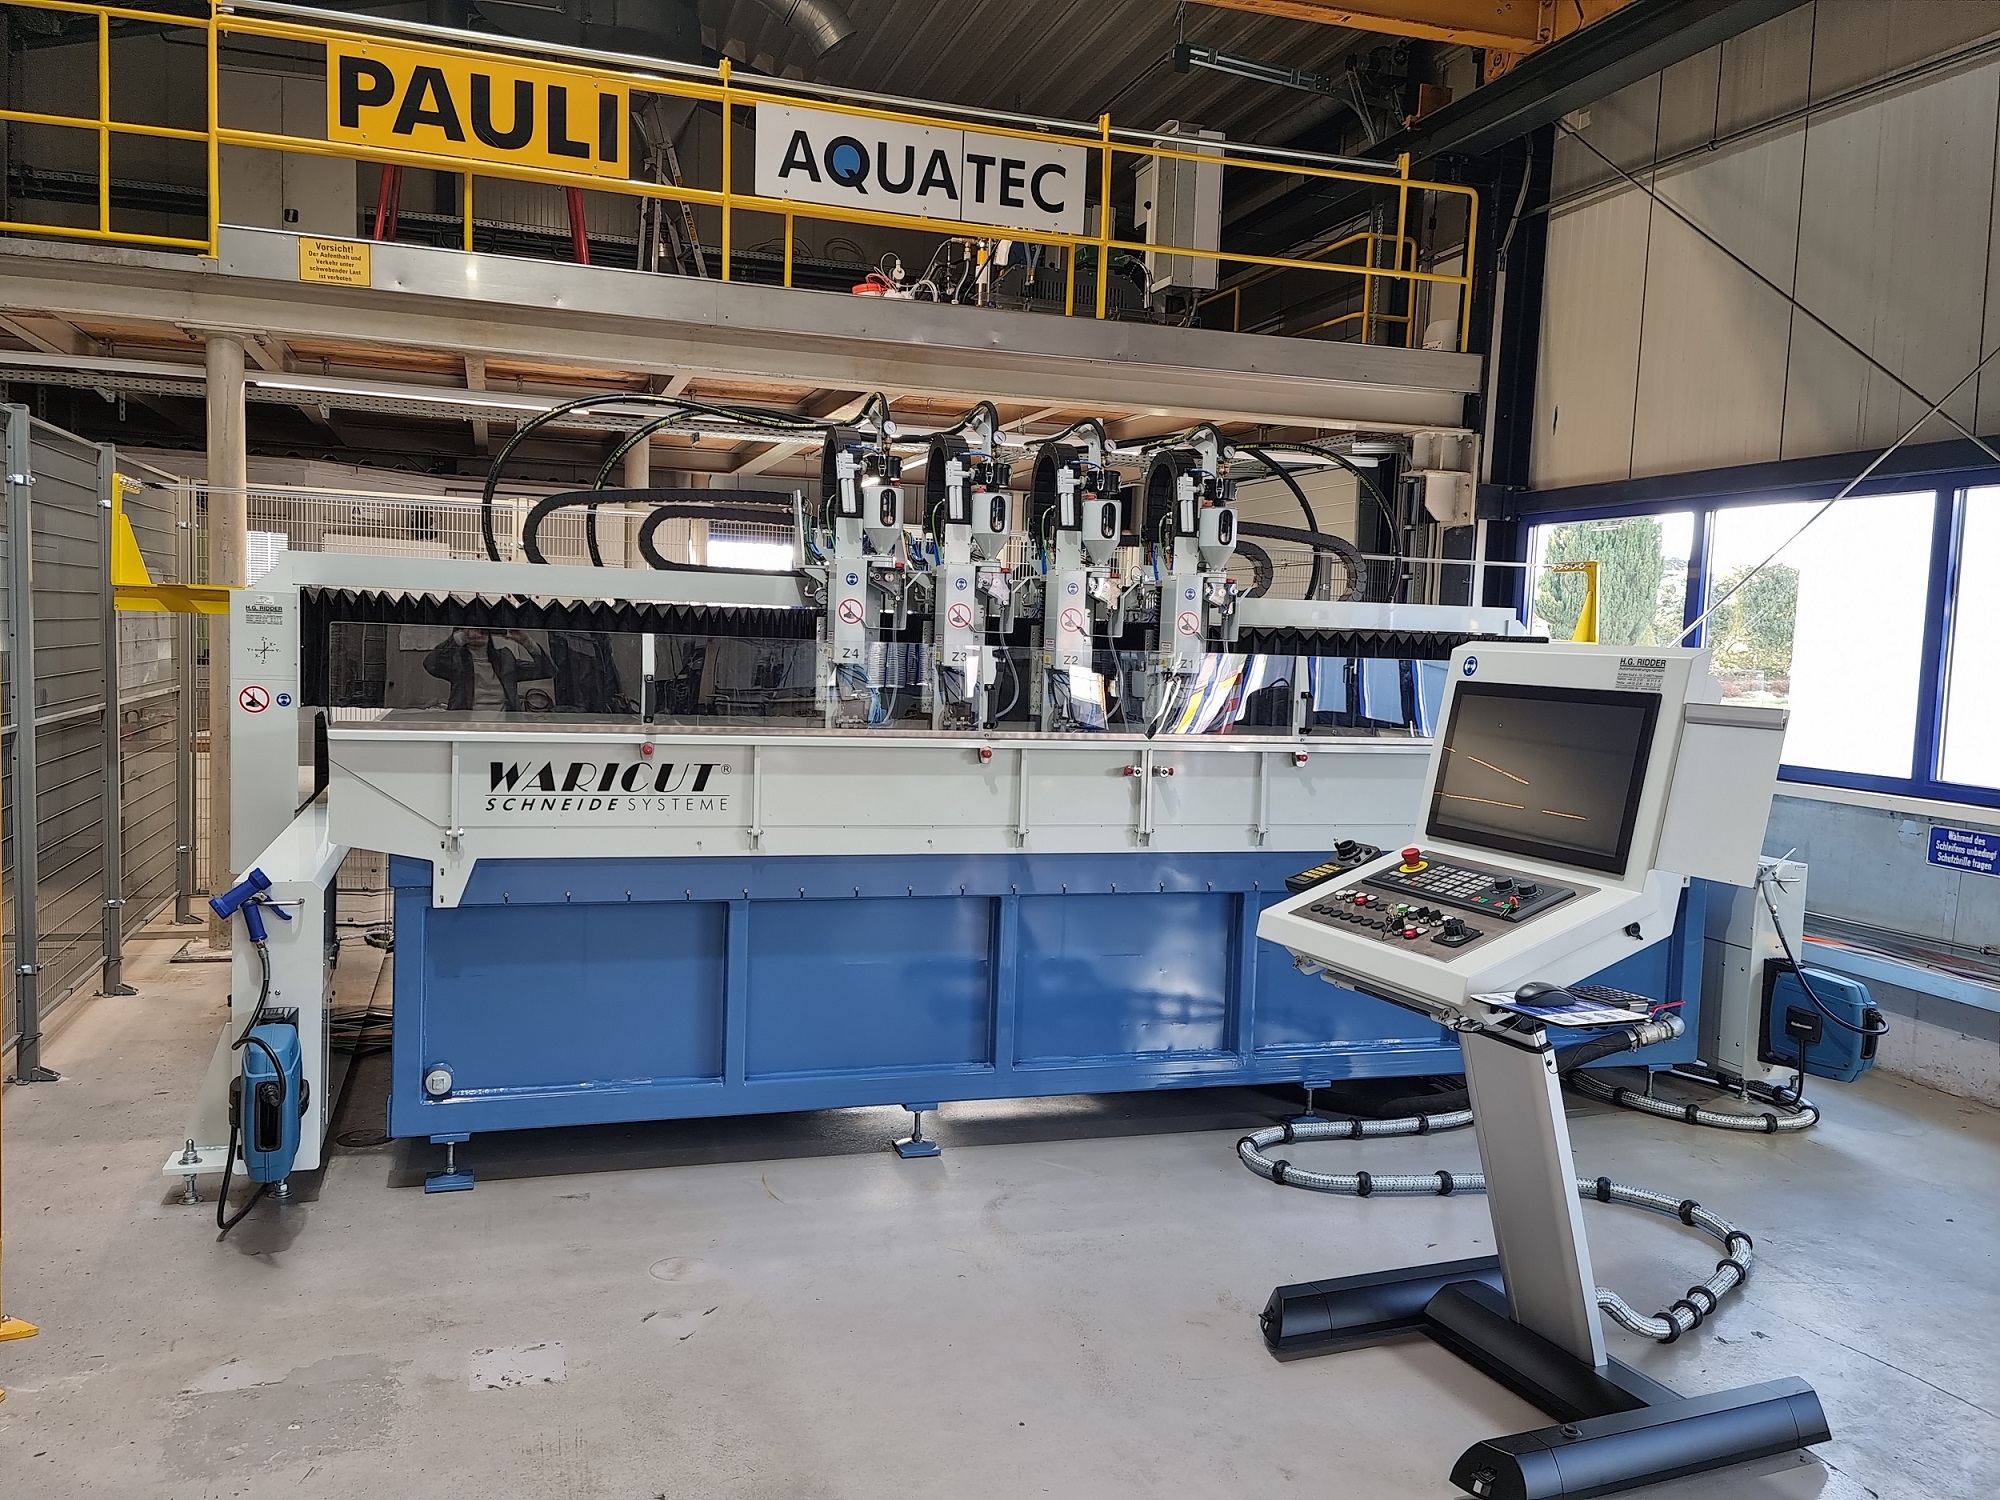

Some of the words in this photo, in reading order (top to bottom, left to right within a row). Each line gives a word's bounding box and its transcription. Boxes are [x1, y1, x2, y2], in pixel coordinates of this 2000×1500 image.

[338, 54, 618, 163] PAULI
[778, 129, 1066, 213] AQUATEC
[315, 242, 354, 254] Vorsicht!
[320, 251, 350, 260] Aufenthalt
[316, 258, 338, 266] Verkehr
[309, 266, 348, 274] schwebender
[842, 648, 859, 659] Z4
[952, 652, 967, 662] Z3
[1063, 655, 1079, 665] Z2
[1180, 659, 1194, 668] Z1
[1620, 658, 1635, 666] H.G.
[1637, 658, 1666, 667] RIDDER
[485, 798, 619, 811] SCHNEIDE
[628, 798, 728, 811] SYSTEME
[1948, 830, 1974, 844] Während
[1974, 835, 1986, 846] des
[1935, 839, 1965, 854] Schleifens
[1966, 846, 1998, 861] unbedingt
[1937, 851, 1972, 866] Schutzbrille
